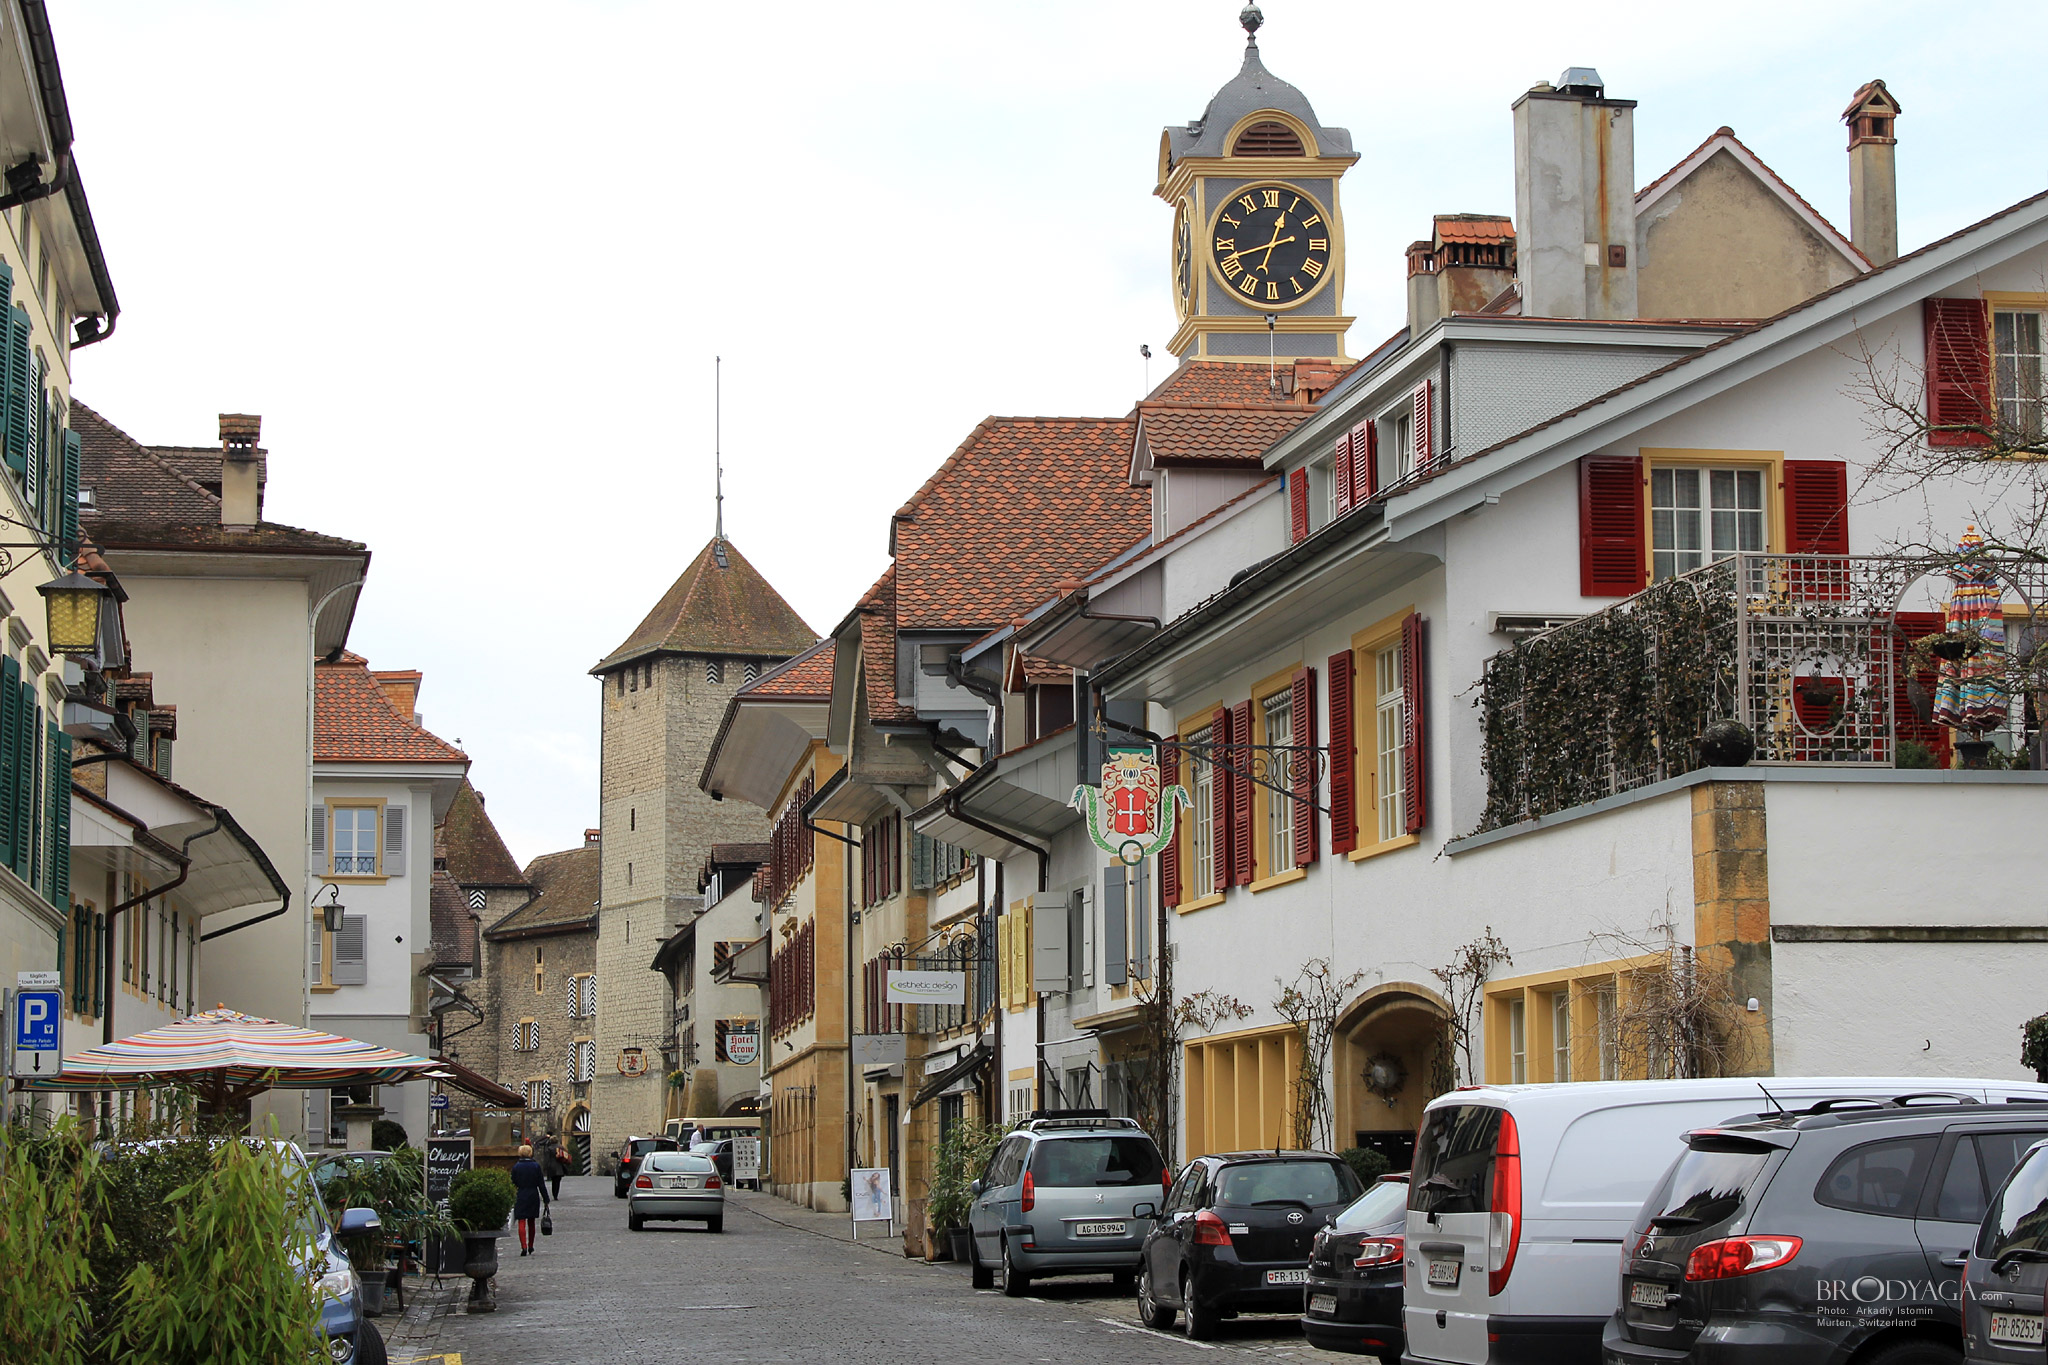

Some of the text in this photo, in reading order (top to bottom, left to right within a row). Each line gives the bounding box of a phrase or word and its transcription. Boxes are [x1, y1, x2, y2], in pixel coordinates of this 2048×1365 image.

[1238, 194, 1258, 215] XI
[1262, 190, 1280, 208] XII
[1288, 196, 1300, 213] I
[1222, 213, 1241, 229] X
[1302, 214, 1321, 230] II
[1217, 237, 1235, 252] IX
[1309, 238, 1327, 252] III
[1220, 257, 1244, 280] VIII
[1301, 257, 1323, 279] IIII
[1239, 273, 1259, 296] VII
[1266, 281, 1279, 300] VI
[1289, 276, 1304, 294] V
[898, 981, 931, 989] esthetic
[932, 981, 958, 991] design
[24, 999, 47, 1034] P
[731, 1035, 754, 1044] Hotel
[730, 1045, 754, 1053] Krone
